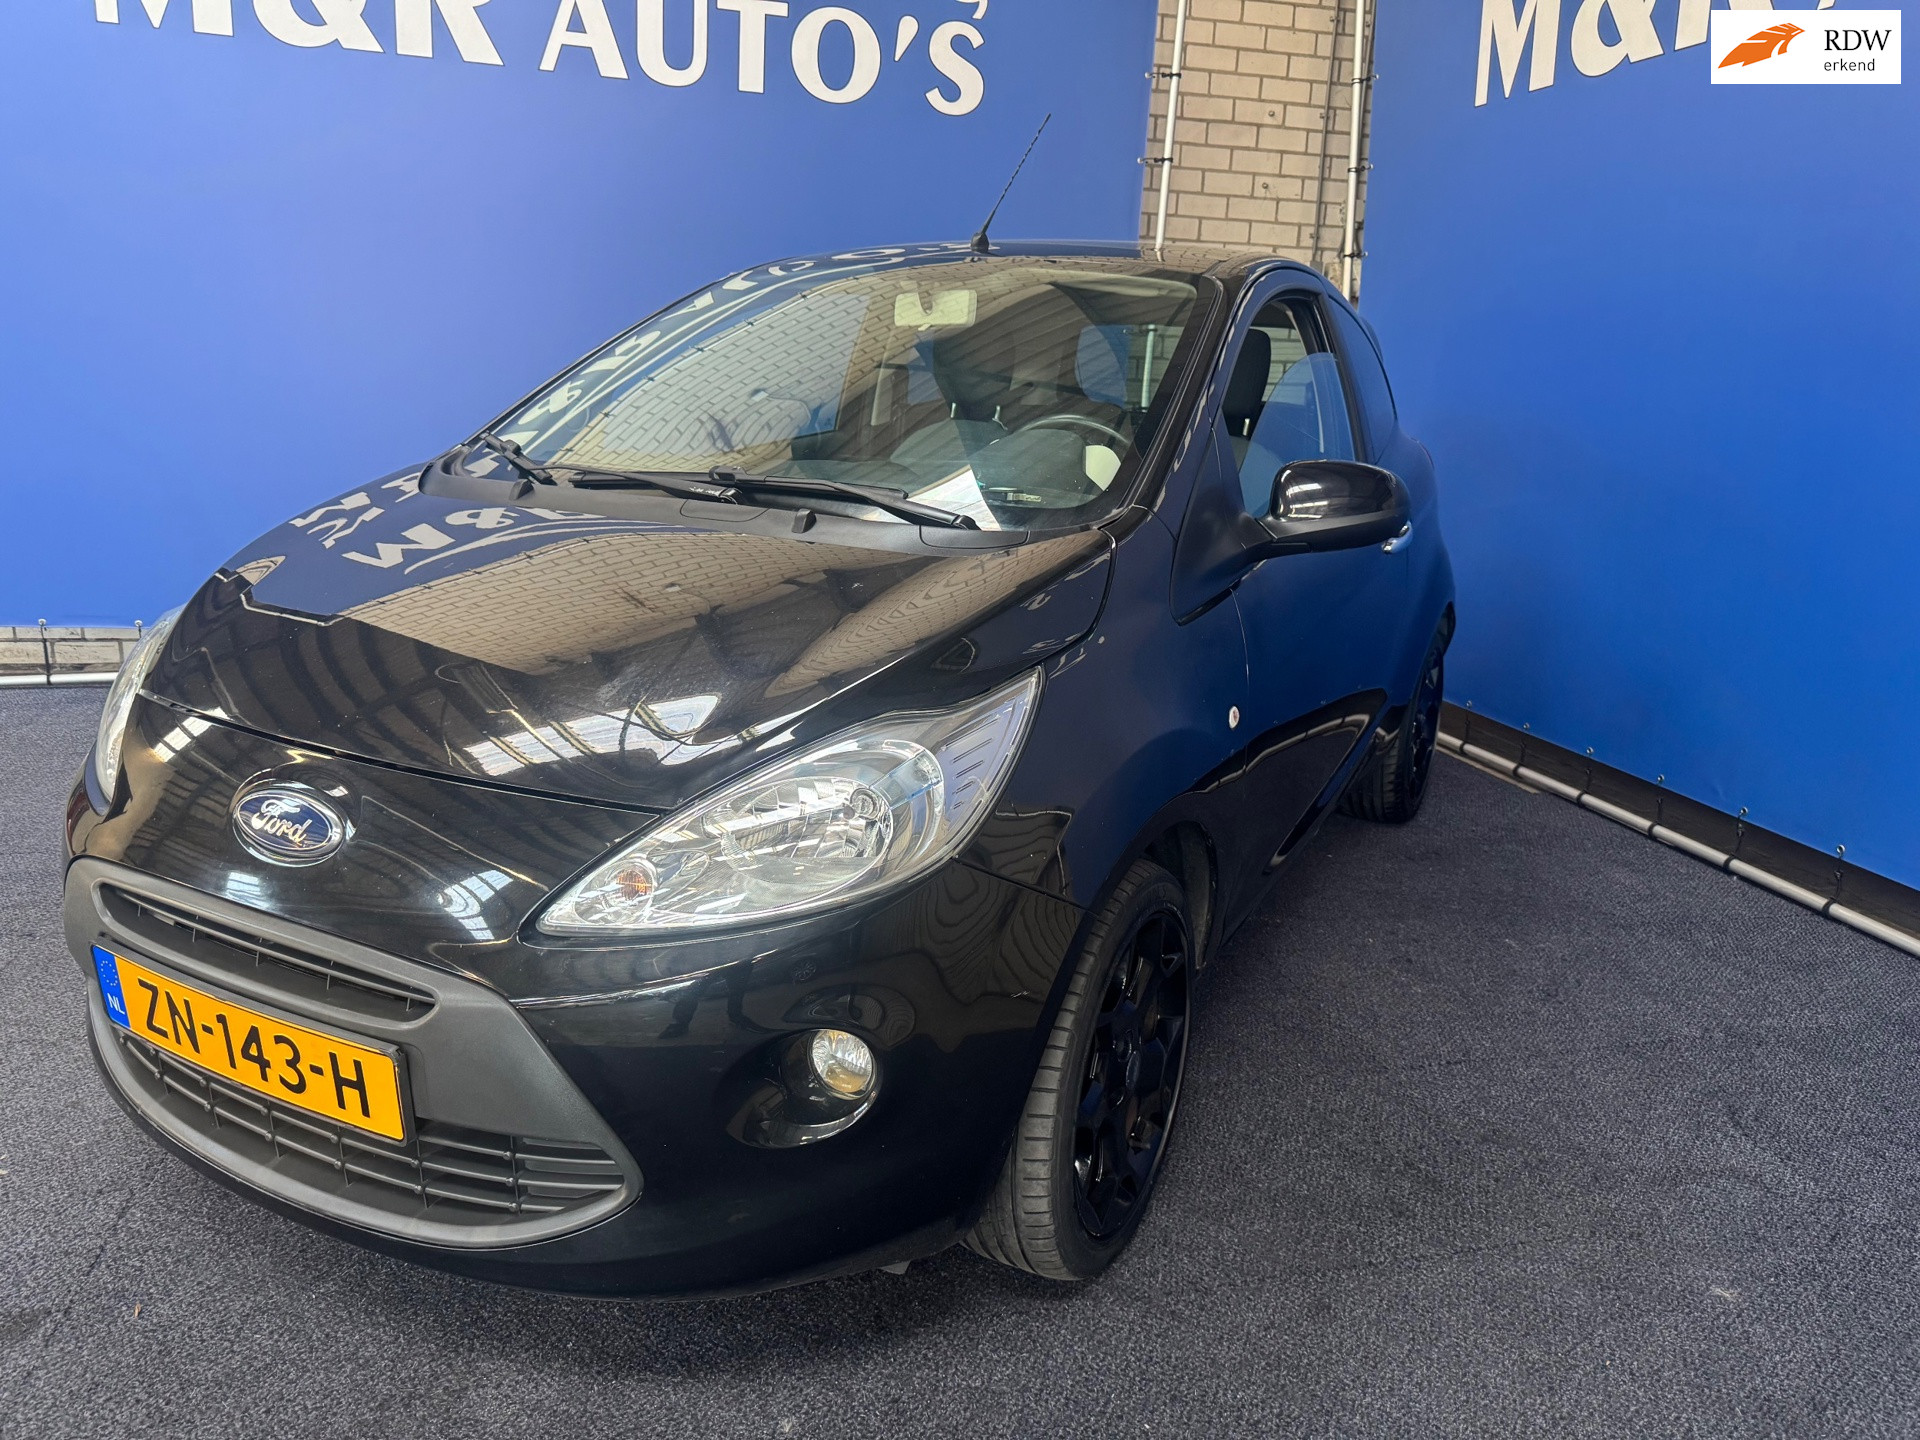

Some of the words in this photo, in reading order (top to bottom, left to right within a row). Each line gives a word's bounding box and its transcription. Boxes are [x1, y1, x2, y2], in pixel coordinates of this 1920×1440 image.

[538, 0, 986, 116] AUTO'S
[251, 799, 313, 847] Ford
[106, 992, 126, 1015] NL
[137, 976, 371, 1119] ZN-143-H
